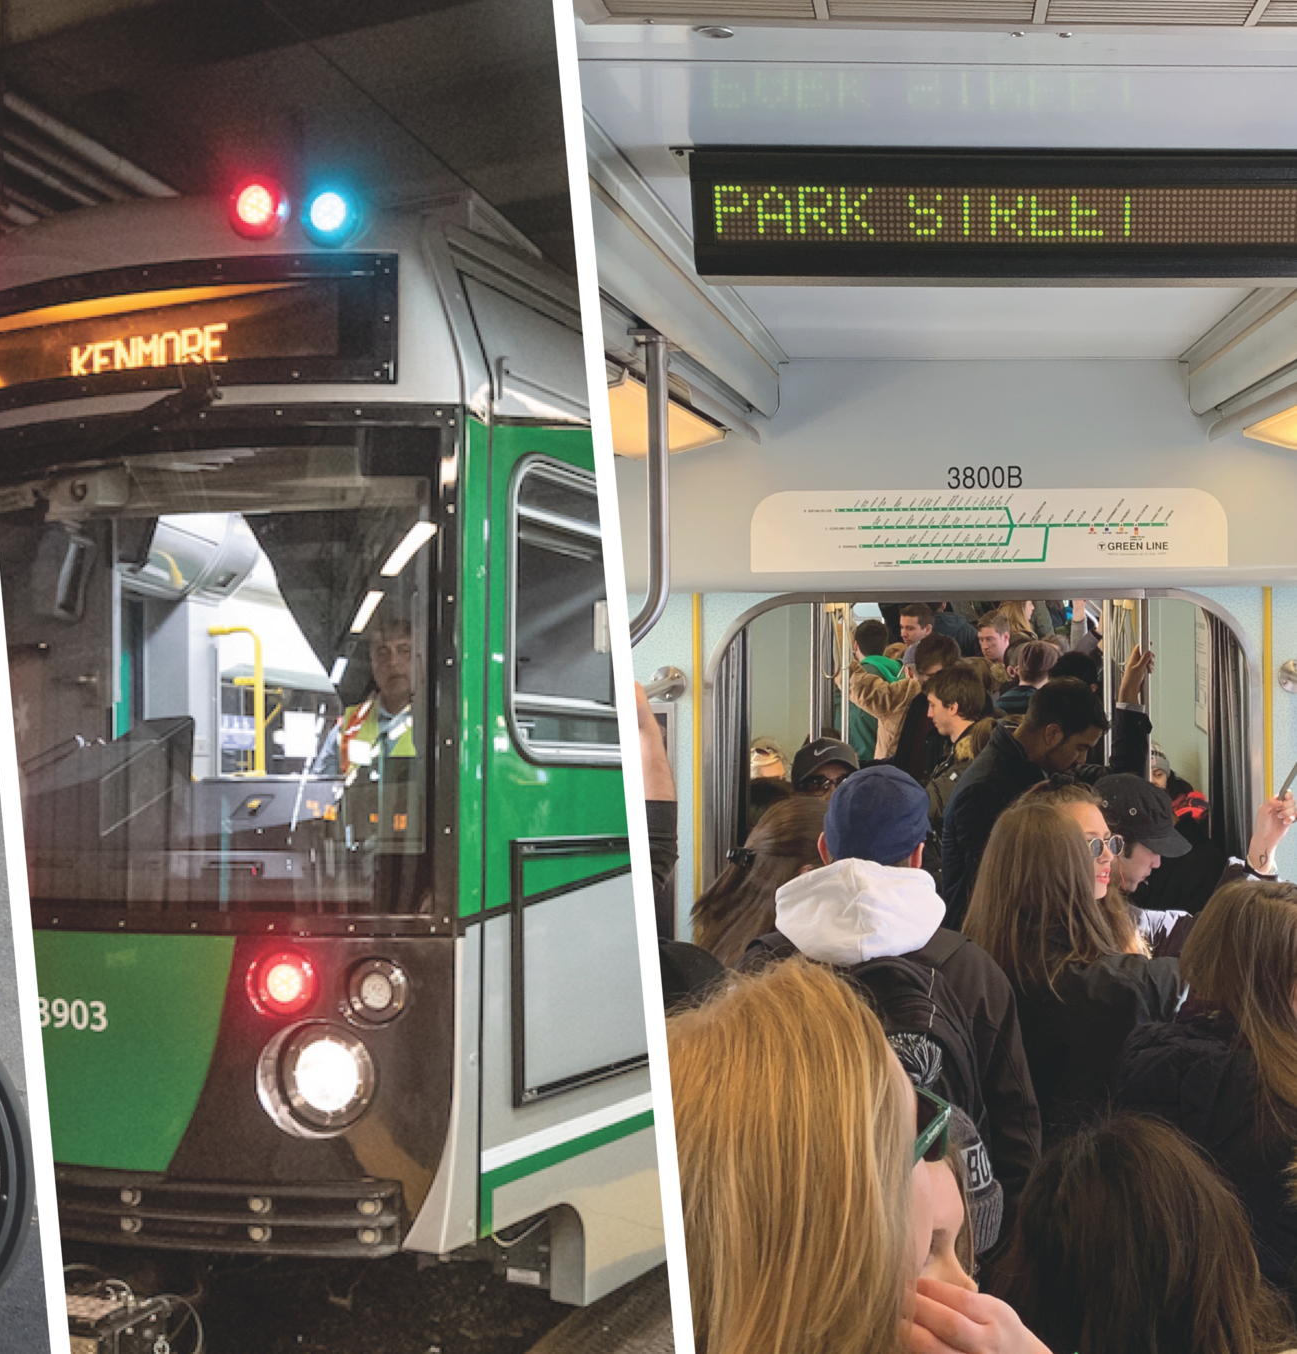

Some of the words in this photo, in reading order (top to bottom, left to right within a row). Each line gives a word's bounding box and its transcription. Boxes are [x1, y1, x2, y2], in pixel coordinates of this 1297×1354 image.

[714, 185, 875, 235] PARK
[70, 322, 229, 377] KENMORE
[947, 465, 1023, 490] 3800B
[1108, 542, 1143, 550] GREEN
[1146, 542, 1169, 550] LINE
[38, 996, 108, 1032] 3903
